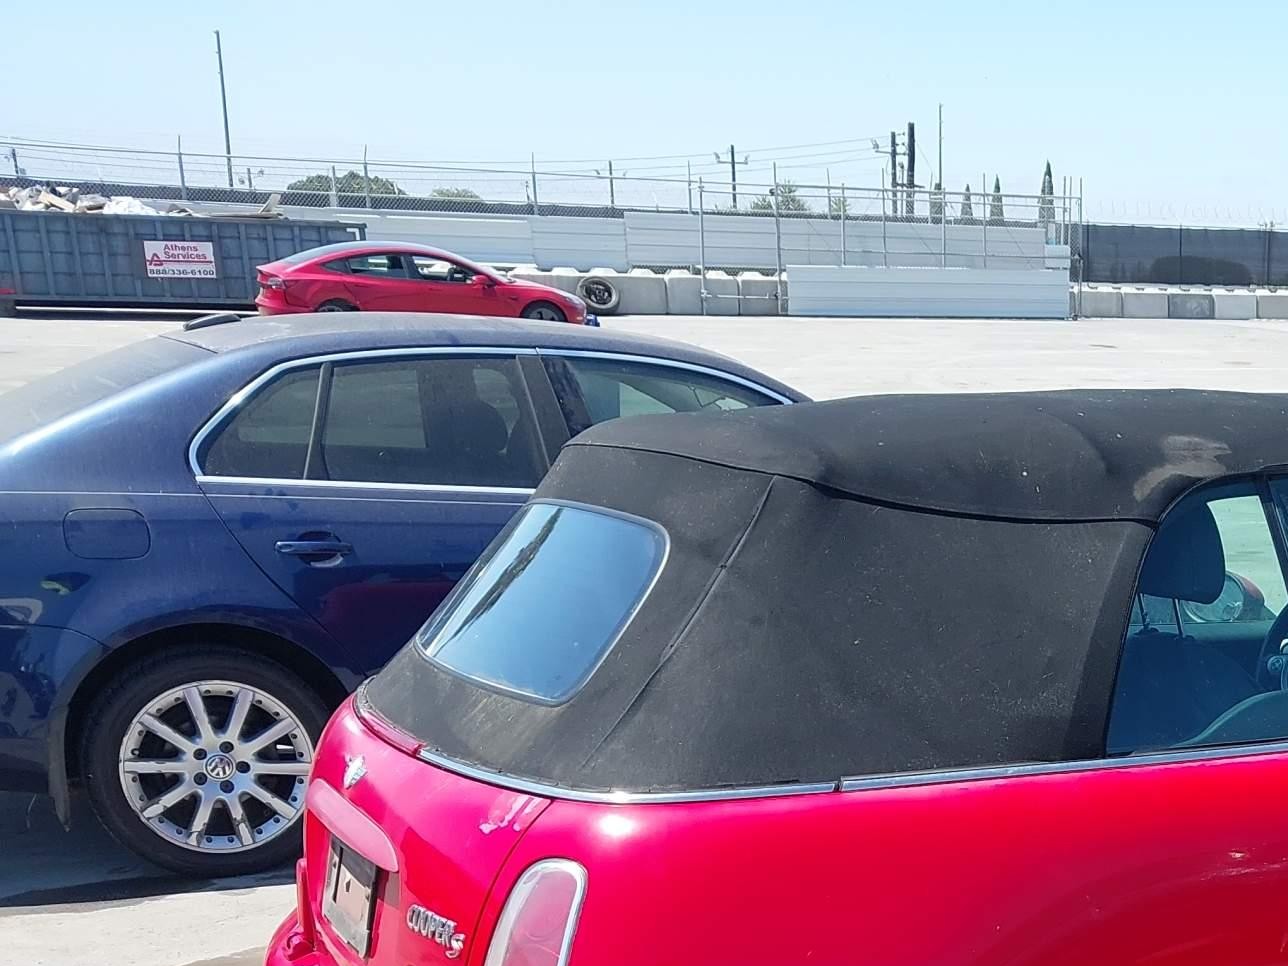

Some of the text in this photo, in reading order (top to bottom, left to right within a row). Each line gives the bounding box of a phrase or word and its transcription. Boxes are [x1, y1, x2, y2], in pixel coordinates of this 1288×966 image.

[163, 244, 198, 252] Athens
[164, 251, 207, 260] Services
[149, 268, 215, 276] 888/336-6100
[407, 904, 466, 959] COOPER S
